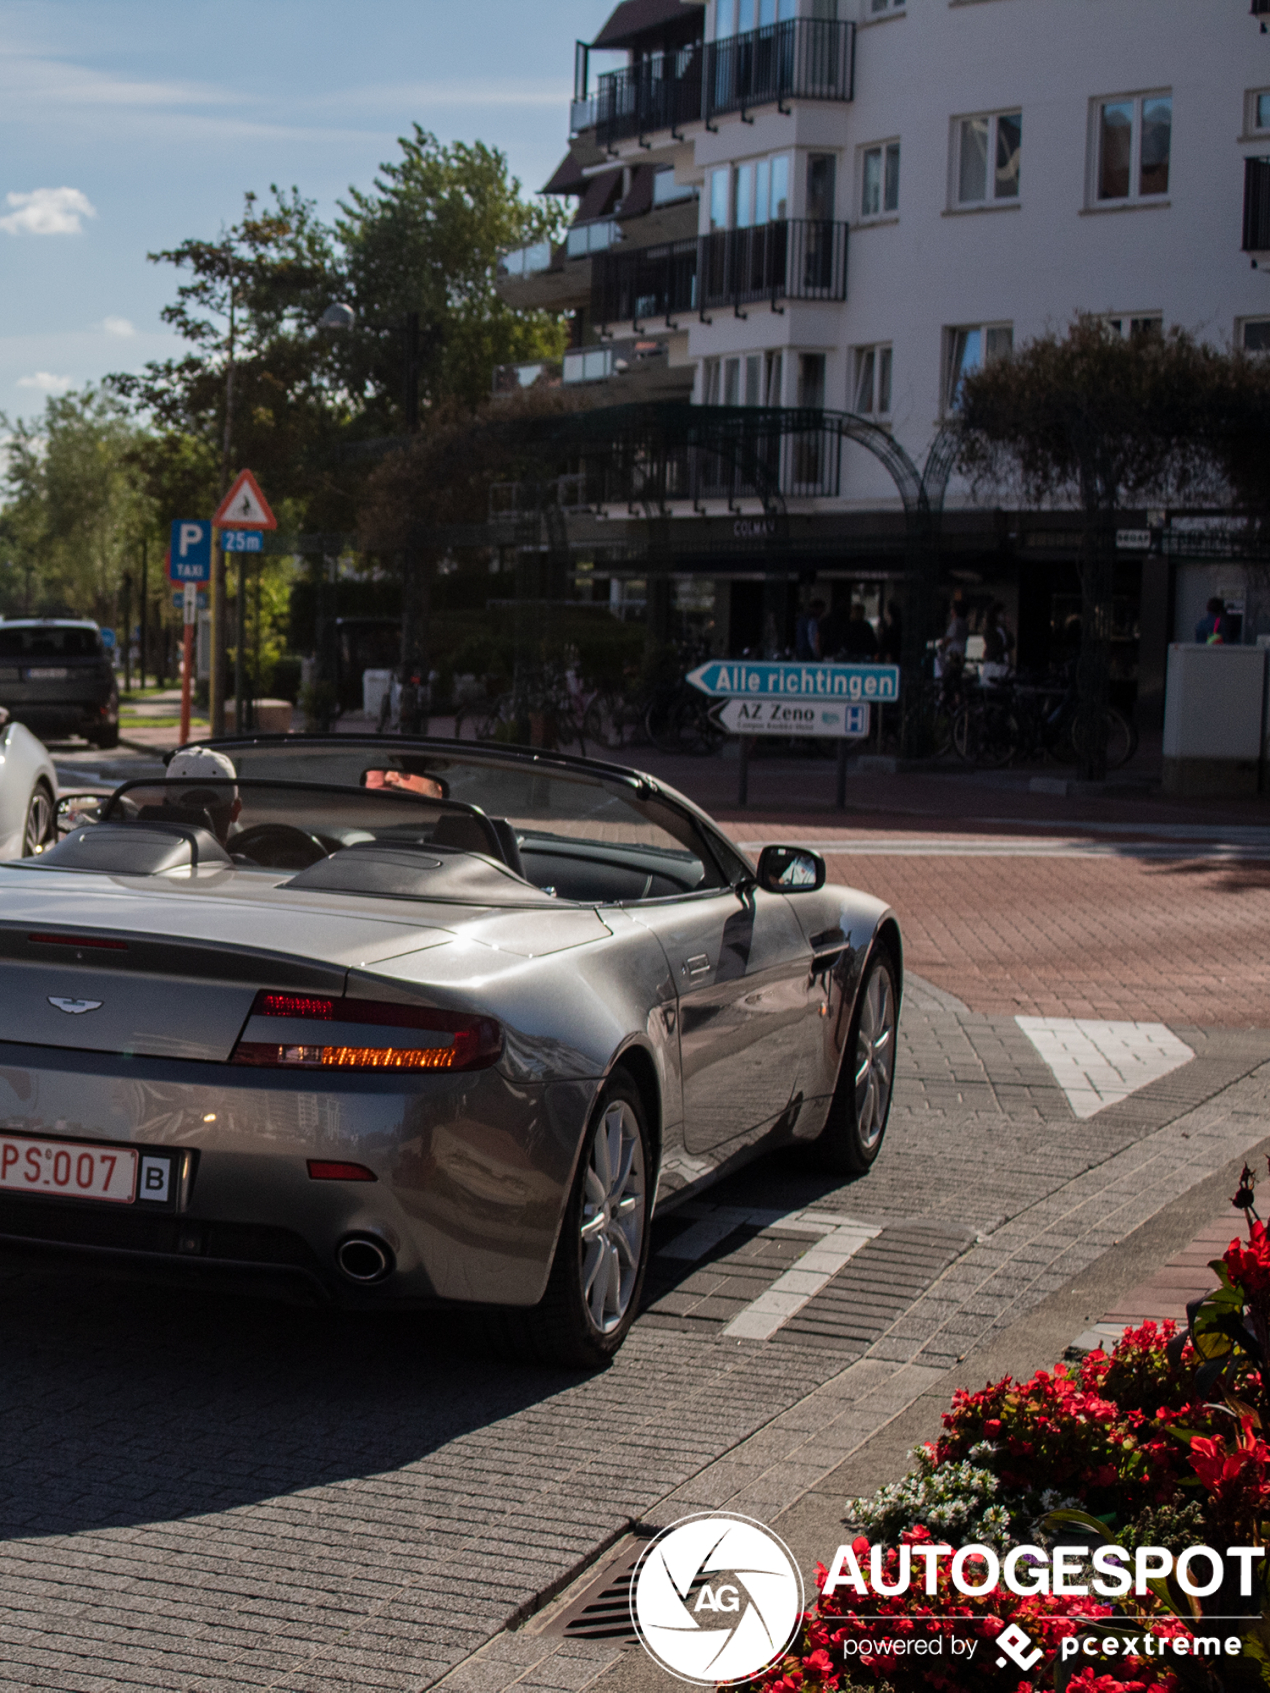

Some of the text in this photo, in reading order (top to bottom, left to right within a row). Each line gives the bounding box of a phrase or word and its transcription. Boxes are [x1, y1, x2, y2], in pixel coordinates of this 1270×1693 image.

[180, 524, 203, 556] P
[226, 532, 260, 550] 25m
[177, 563, 203, 577] TAXI
[716, 667, 893, 701] Alle richtingen
[738, 703, 762, 720] AZ
[770, 704, 815, 721] Zeno
[145, 1167, 164, 1190] B
